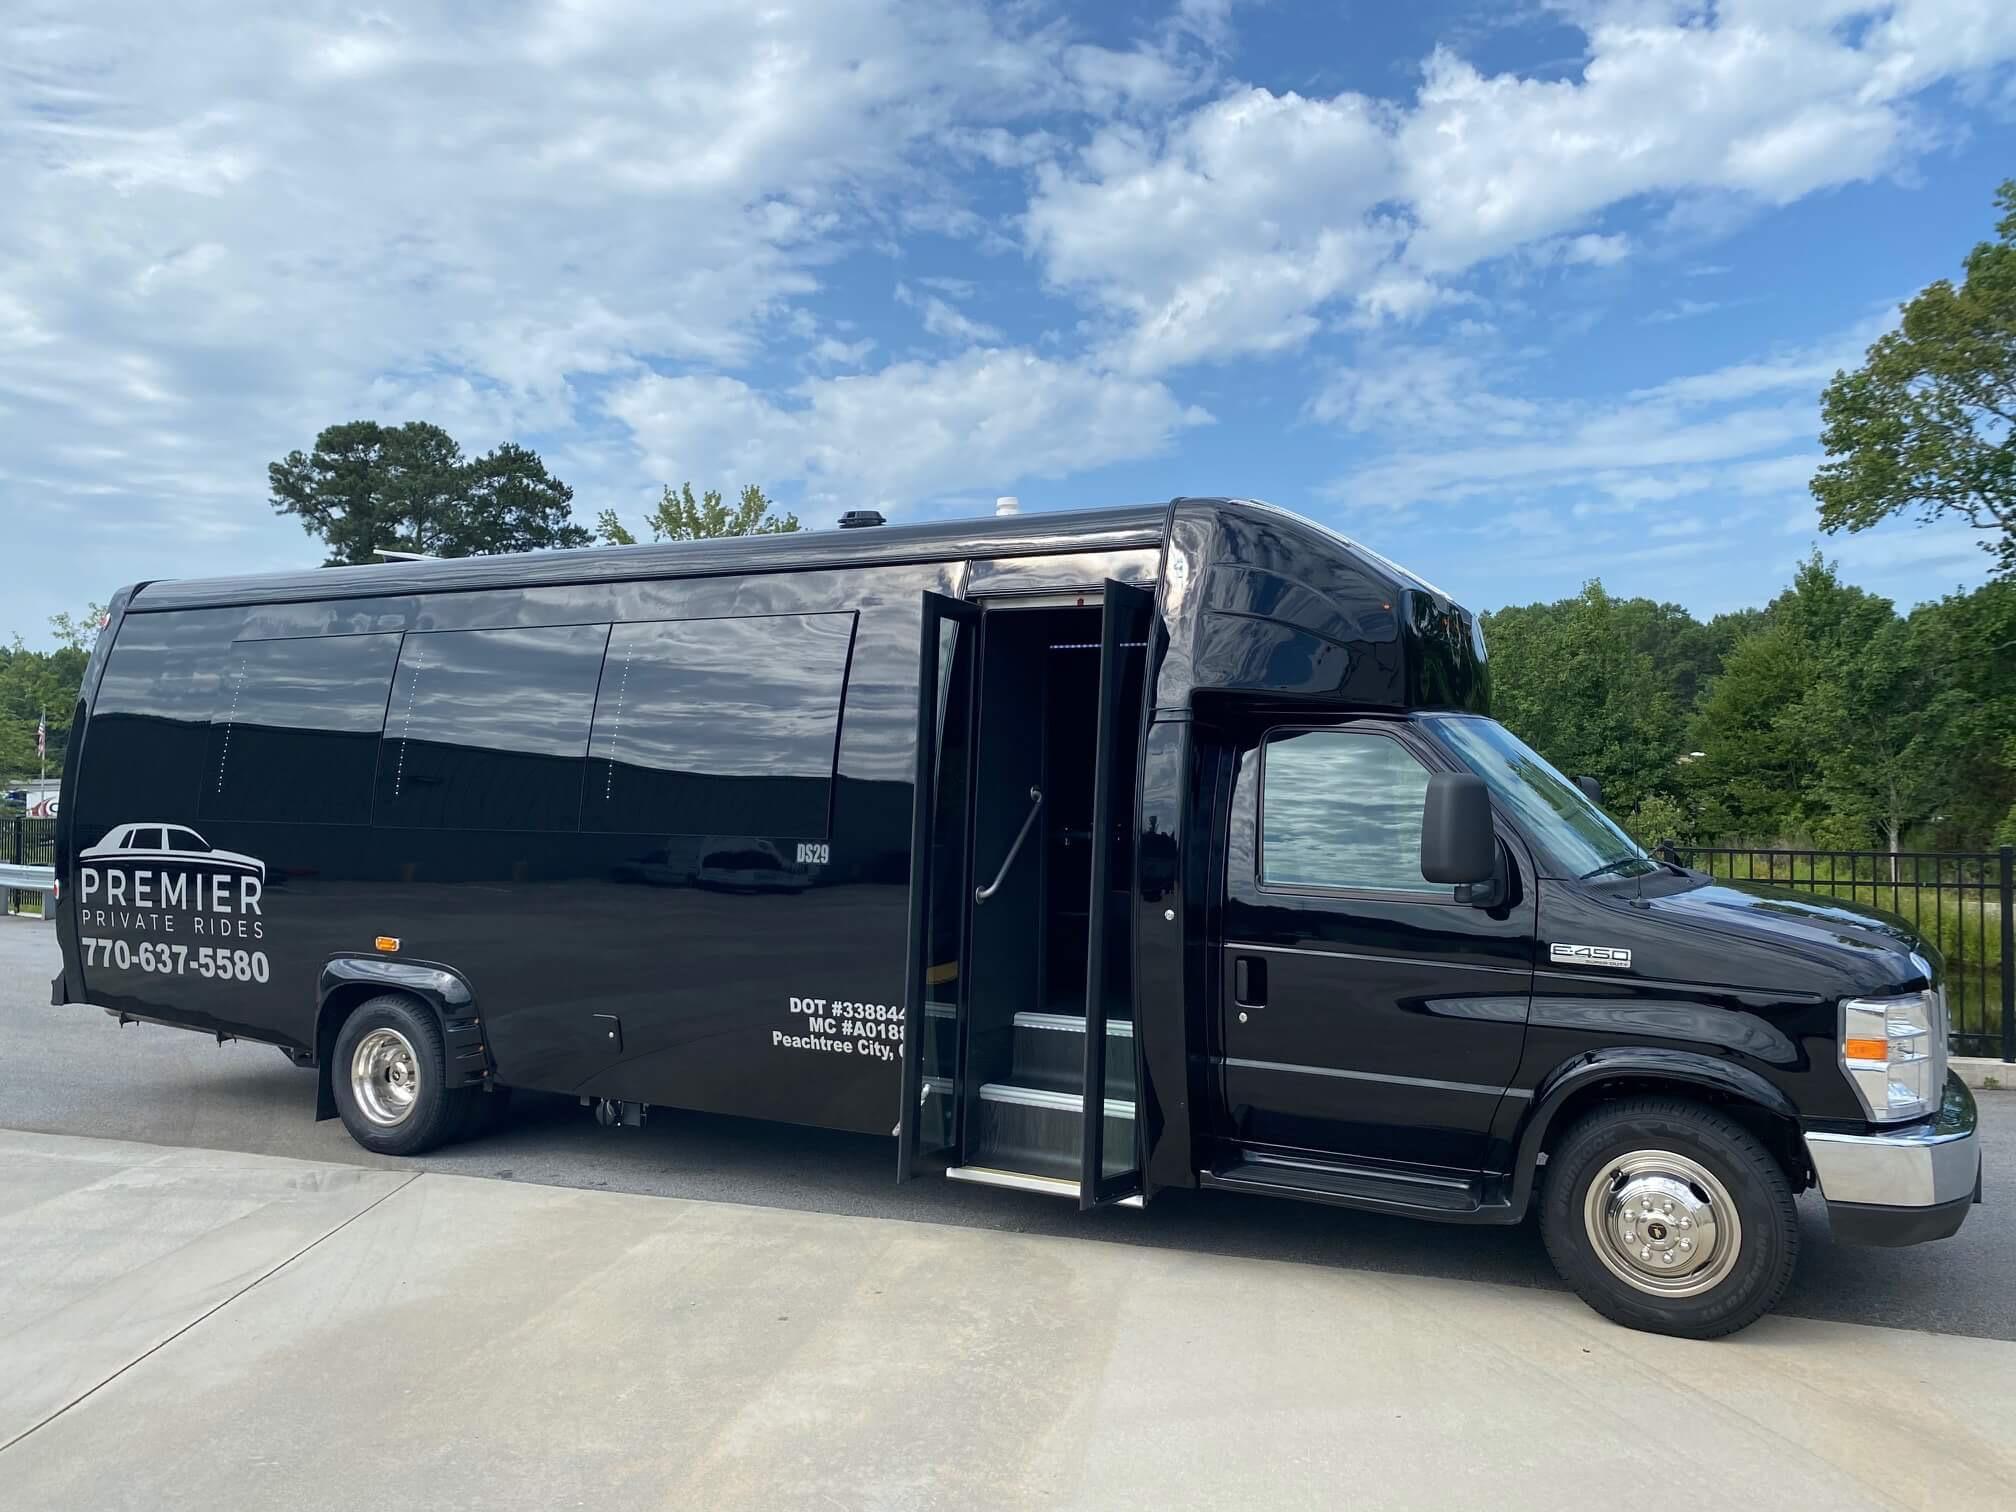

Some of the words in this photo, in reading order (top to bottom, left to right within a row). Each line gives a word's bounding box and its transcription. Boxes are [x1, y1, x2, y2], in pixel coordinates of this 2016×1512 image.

[796, 843, 830, 864] DS29
[81, 868, 263, 915] PREMIER
[82, 910, 174, 932] PRIVATE
[194, 917, 264, 939] RIDES
[81, 937, 270, 983] 770-637-5580
[789, 998, 827, 1015] DOT
[809, 1017, 837, 1034] MC
[772, 1031, 853, 1054] Peachtree
[857, 1038, 895, 1061] City,
